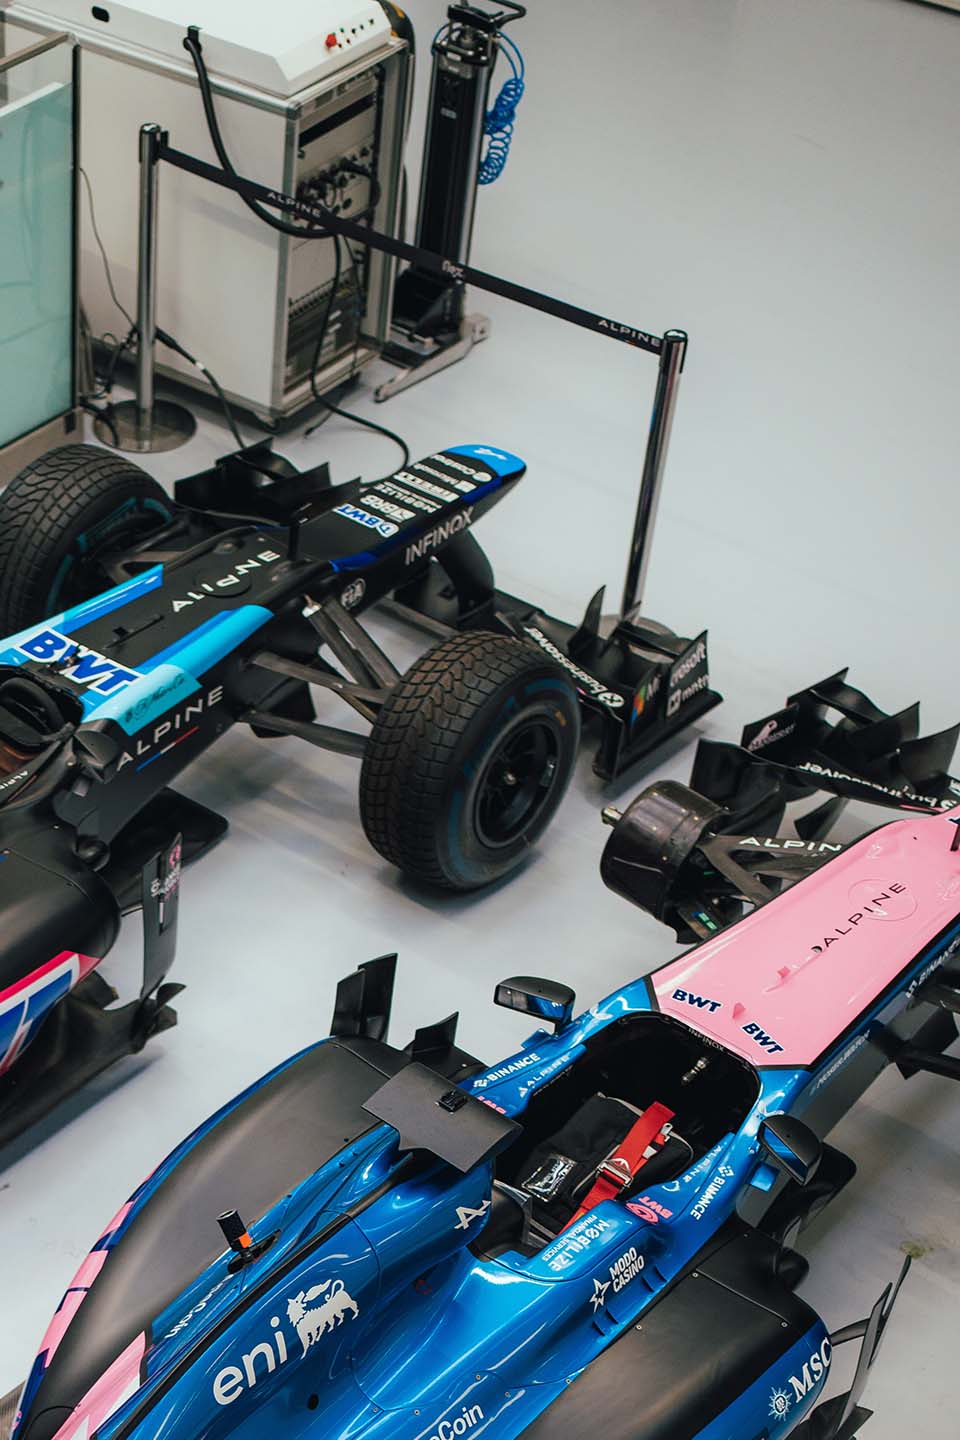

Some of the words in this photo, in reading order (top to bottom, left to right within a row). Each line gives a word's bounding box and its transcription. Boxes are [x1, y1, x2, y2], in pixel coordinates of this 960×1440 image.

[267, 191, 322, 217] ALPINE
[598, 319, 662, 348] ALPINE
[405, 507, 474, 565] INFINOX
[14, 626, 149, 695] BWT
[117, 685, 224, 772] ALPINE
[740, 836, 842, 852] ALPIN
[823, 882, 906, 948] ALPINE
[671, 989, 721, 1014] BWT
[741, 1022, 784, 1055] BWT
[487, 1052, 540, 1081] BINANCE
[690, 1176, 725, 1221] BINANCE
[609, 1247, 638, 1281] MODO
[613, 1254, 645, 1293] CASINO
[212, 1316, 287, 1406] eni
[788, 1337, 832, 1403] MSC
